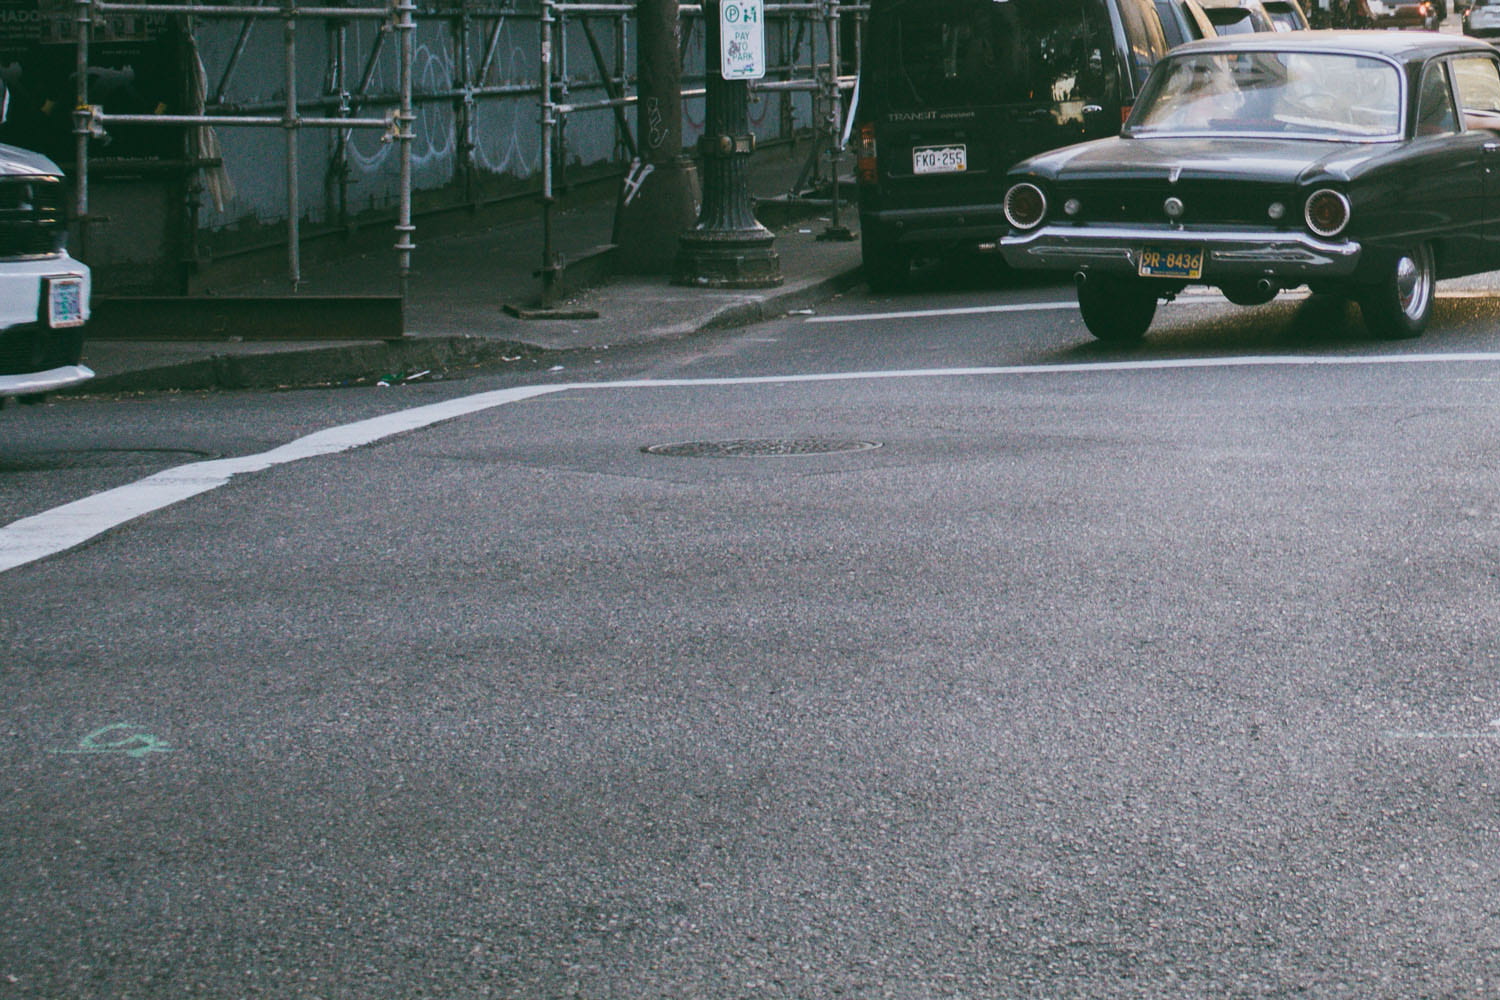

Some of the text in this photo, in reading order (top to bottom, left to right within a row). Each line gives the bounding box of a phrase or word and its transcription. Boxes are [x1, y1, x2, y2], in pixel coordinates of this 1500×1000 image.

[735, 31, 750, 41] PAY
[732, 52, 753, 61] PARK
[1143, 252, 1199, 269] 9R-8436
